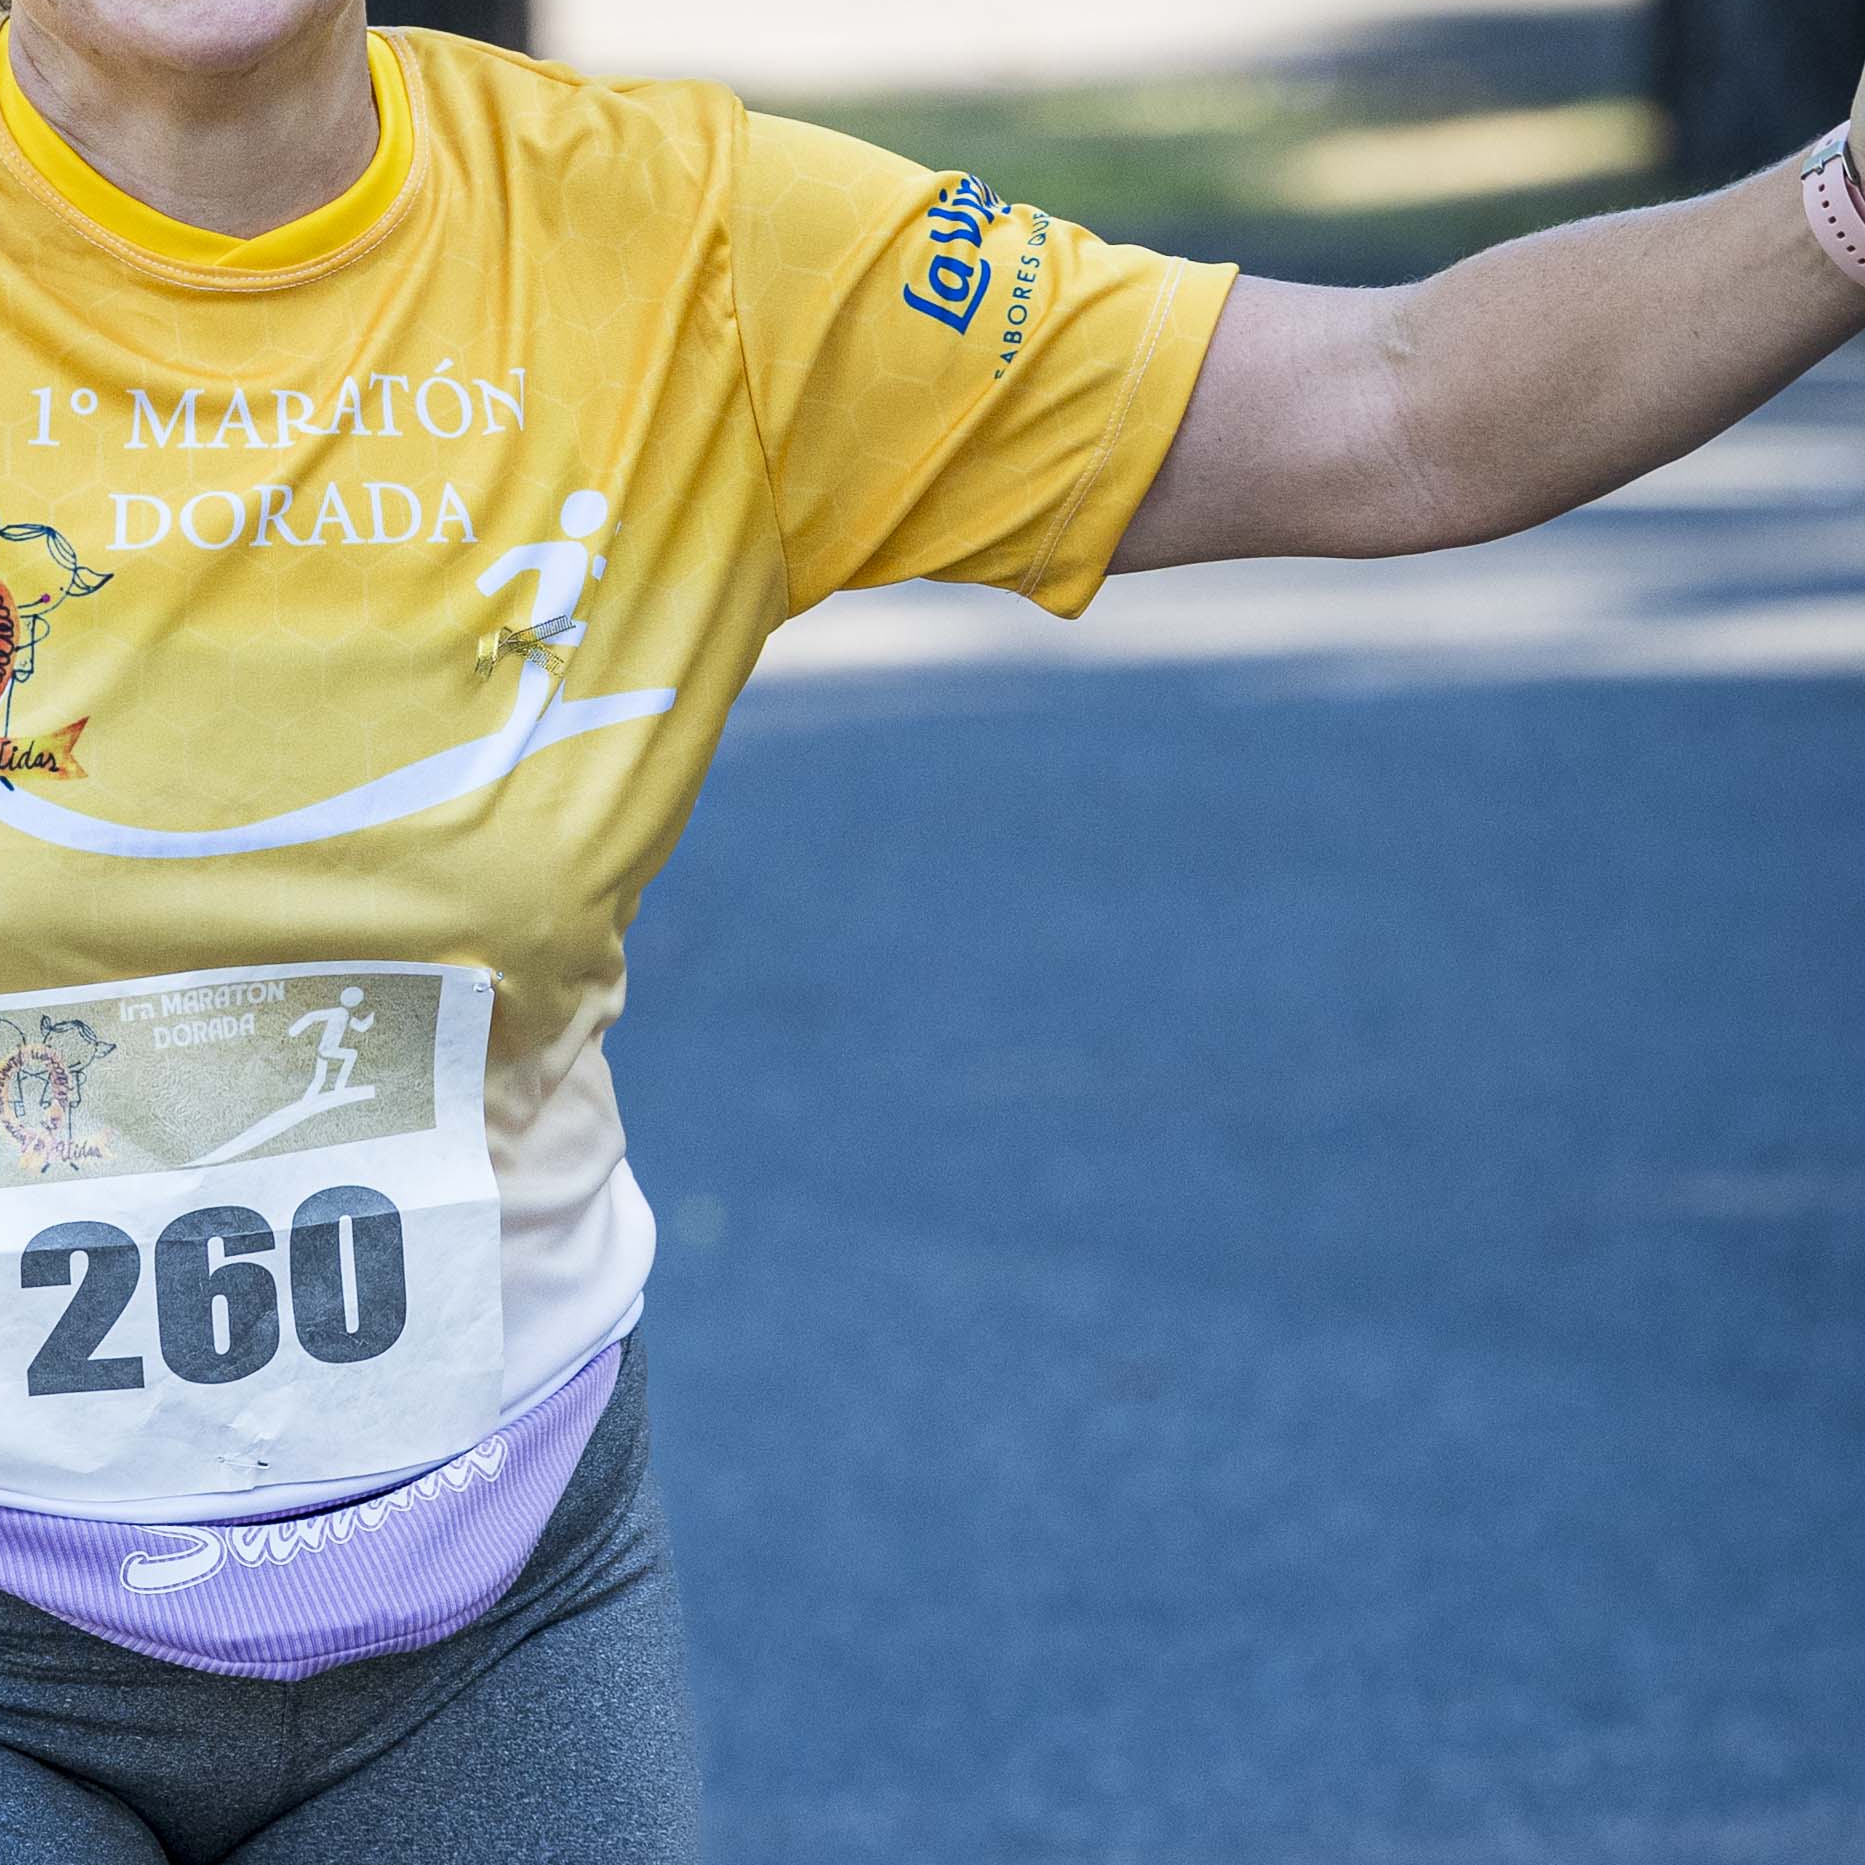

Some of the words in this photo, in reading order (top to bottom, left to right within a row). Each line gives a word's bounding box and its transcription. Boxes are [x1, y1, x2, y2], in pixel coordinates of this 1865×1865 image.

[123, 358, 527, 450] MARATÓN
[105, 481, 480, 552] DORADA
[152, 1011, 255, 1049] DORADA
[20, 1185, 408, 1397] 260
